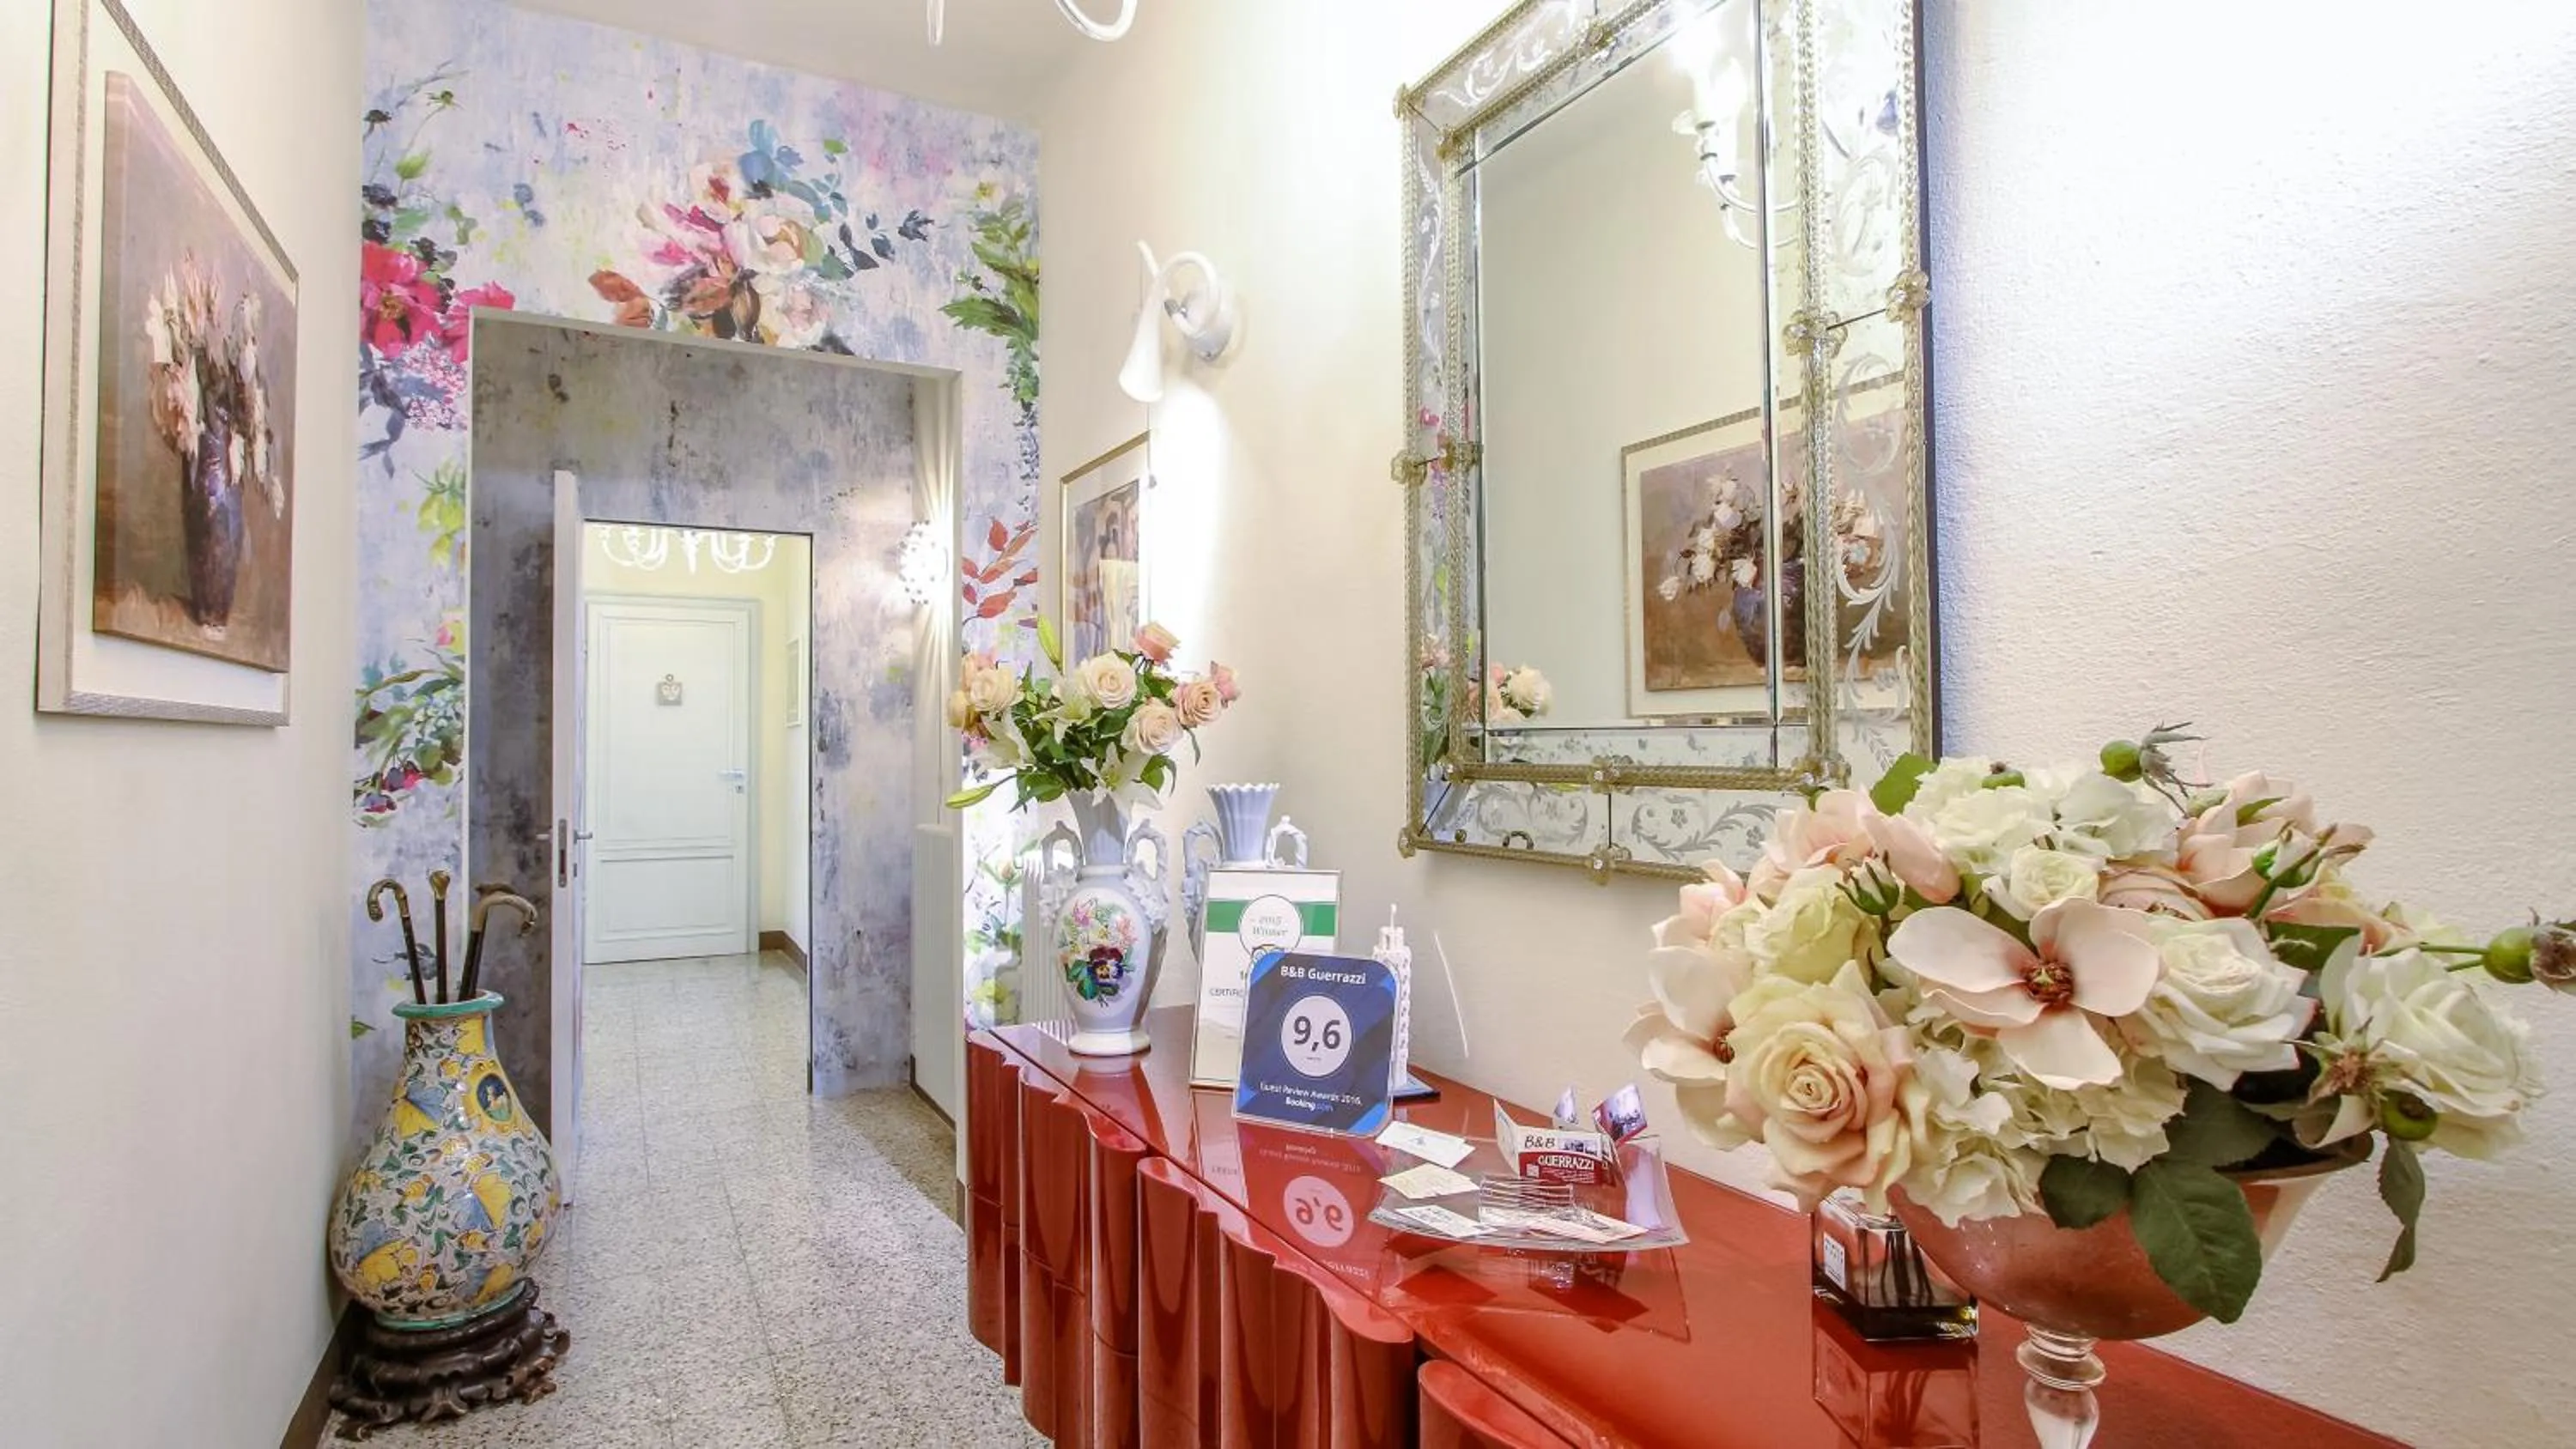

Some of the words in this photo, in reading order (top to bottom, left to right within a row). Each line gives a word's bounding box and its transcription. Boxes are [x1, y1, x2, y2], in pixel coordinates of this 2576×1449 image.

[1280, 966, 1304, 979] B&B
[1308, 967, 1367, 985] Guerrazzi
[1293, 1016, 1341, 1052] 9,6
[1524, 1134, 1555, 1149] B&B
[1538, 1155, 1595, 1172] GUERRAZZI
